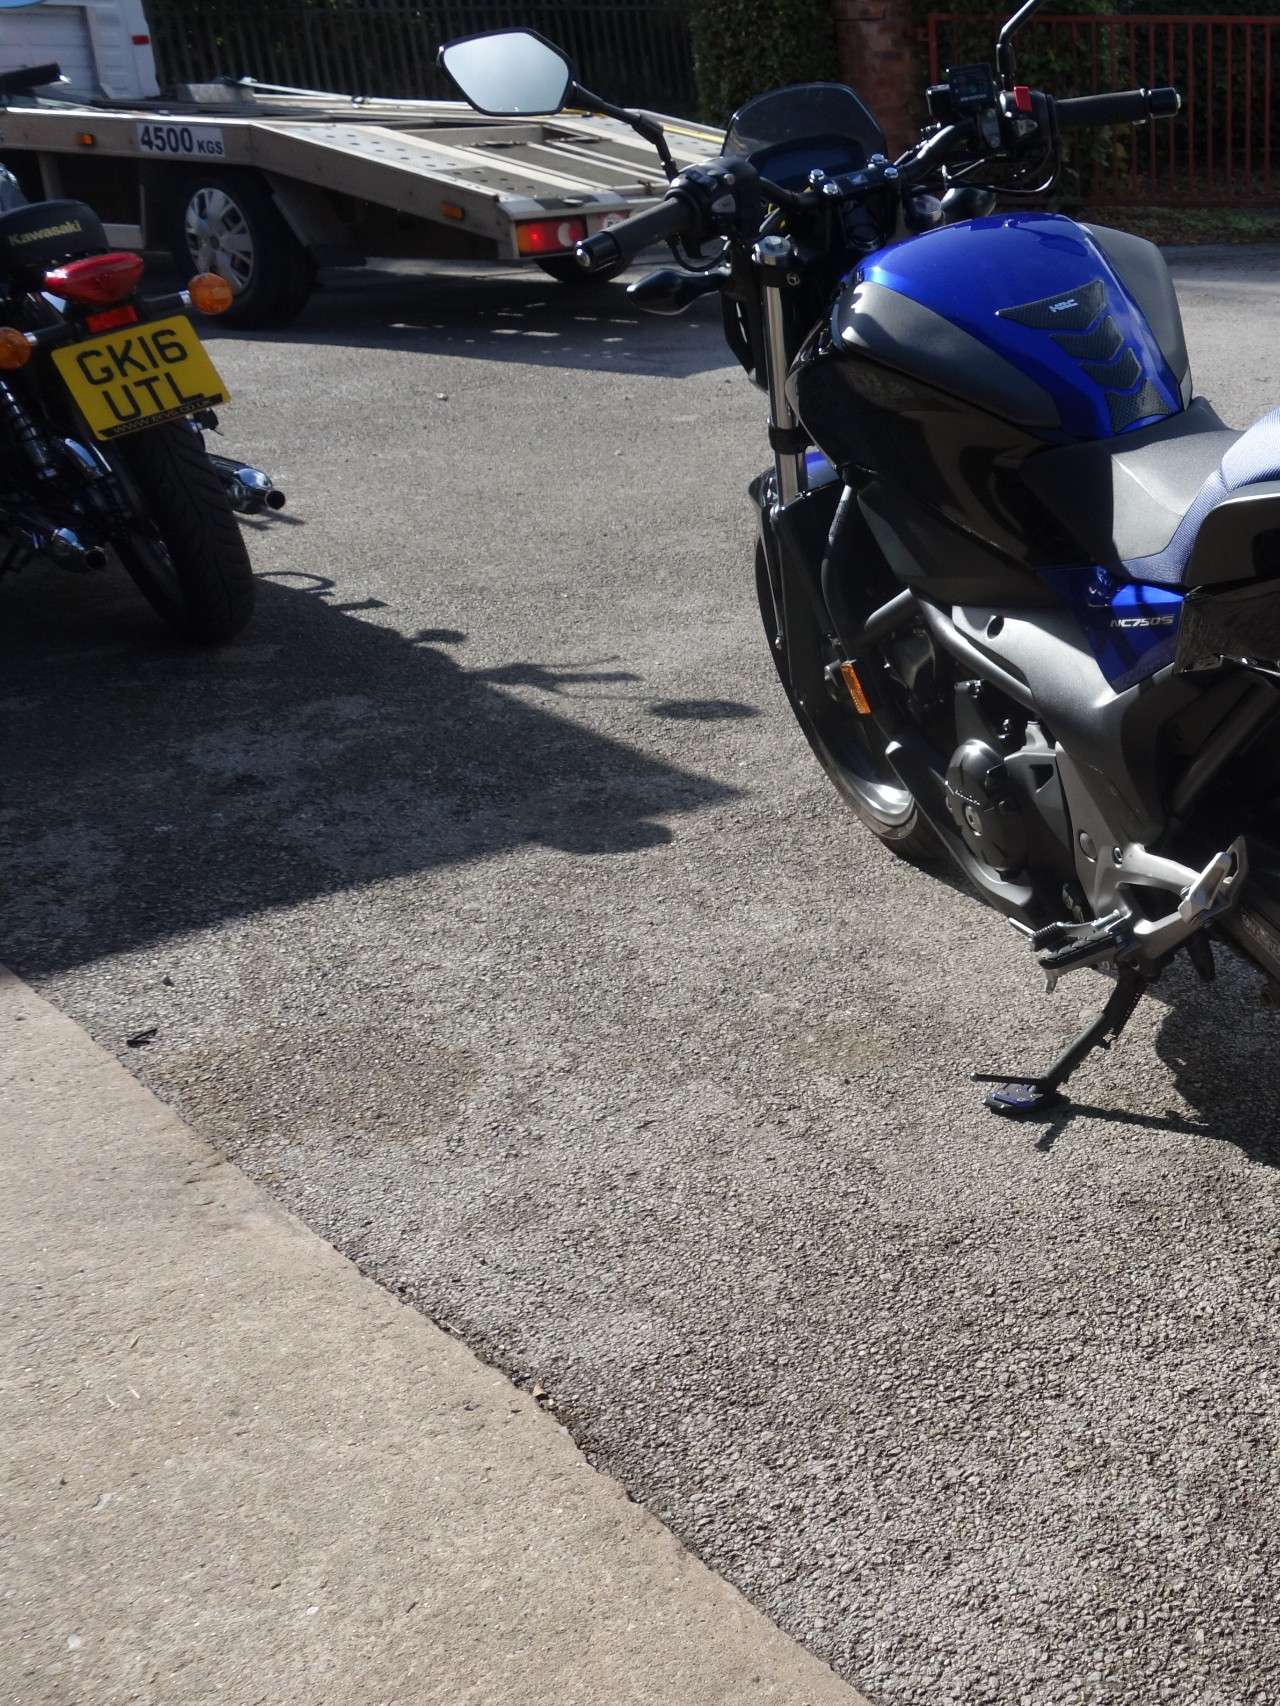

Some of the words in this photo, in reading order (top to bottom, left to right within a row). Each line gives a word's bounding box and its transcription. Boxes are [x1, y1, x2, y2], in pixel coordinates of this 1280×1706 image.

[140, 124, 194, 153] 4500
[197, 140, 224, 155] KGS
[8, 218, 83, 247] Kawasaki
[76, 328, 189, 386] GK16
[101, 371, 205, 422] UTL
[1110, 615, 1175, 628] NC750S
